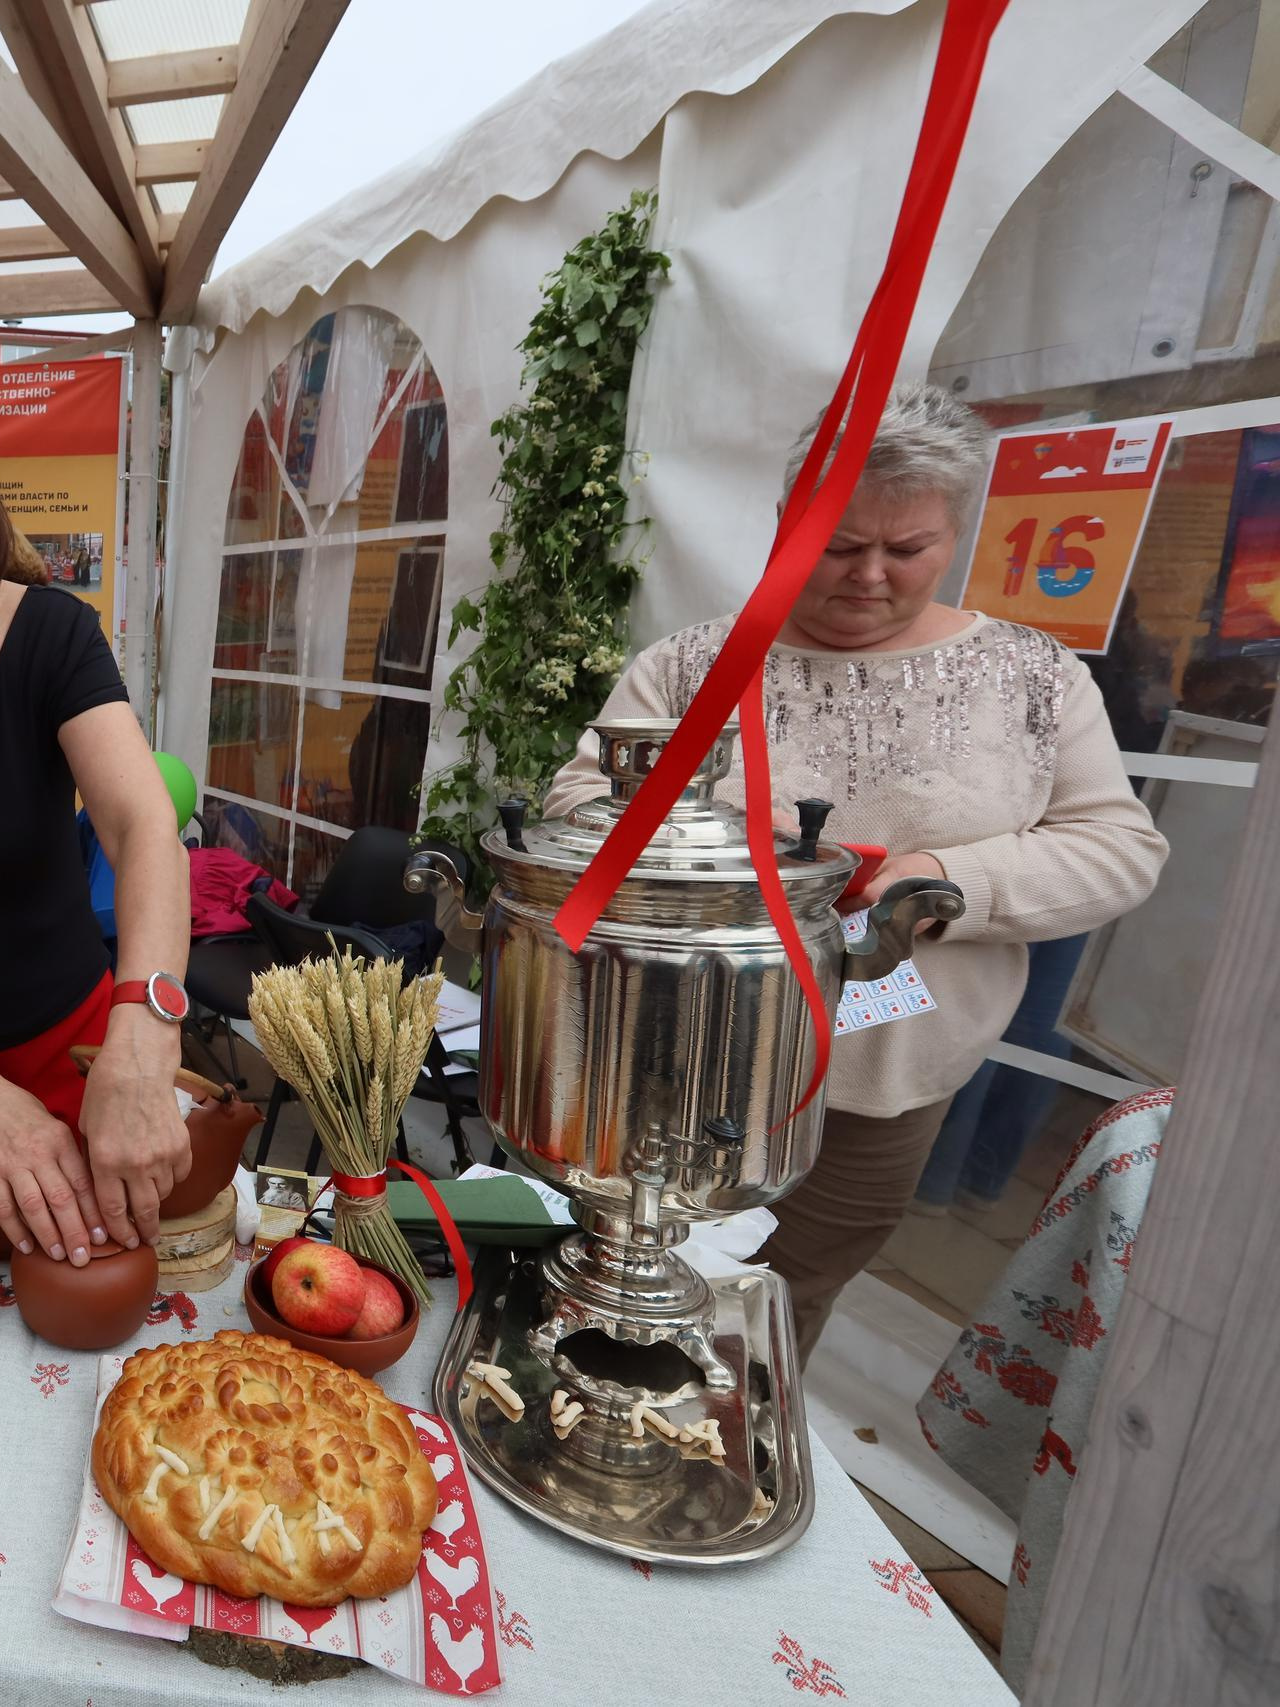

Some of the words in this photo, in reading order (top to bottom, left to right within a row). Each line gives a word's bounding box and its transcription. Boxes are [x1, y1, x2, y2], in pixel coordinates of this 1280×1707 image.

[2, 370, 76, 384] ОТДЕЛЕНИЕ
[1002, 515, 1106, 598] 16
[908, 994, 920, 1009] НКО
[853, 1010, 864, 1024] НКО
[881, 1002, 892, 1017] НКО
